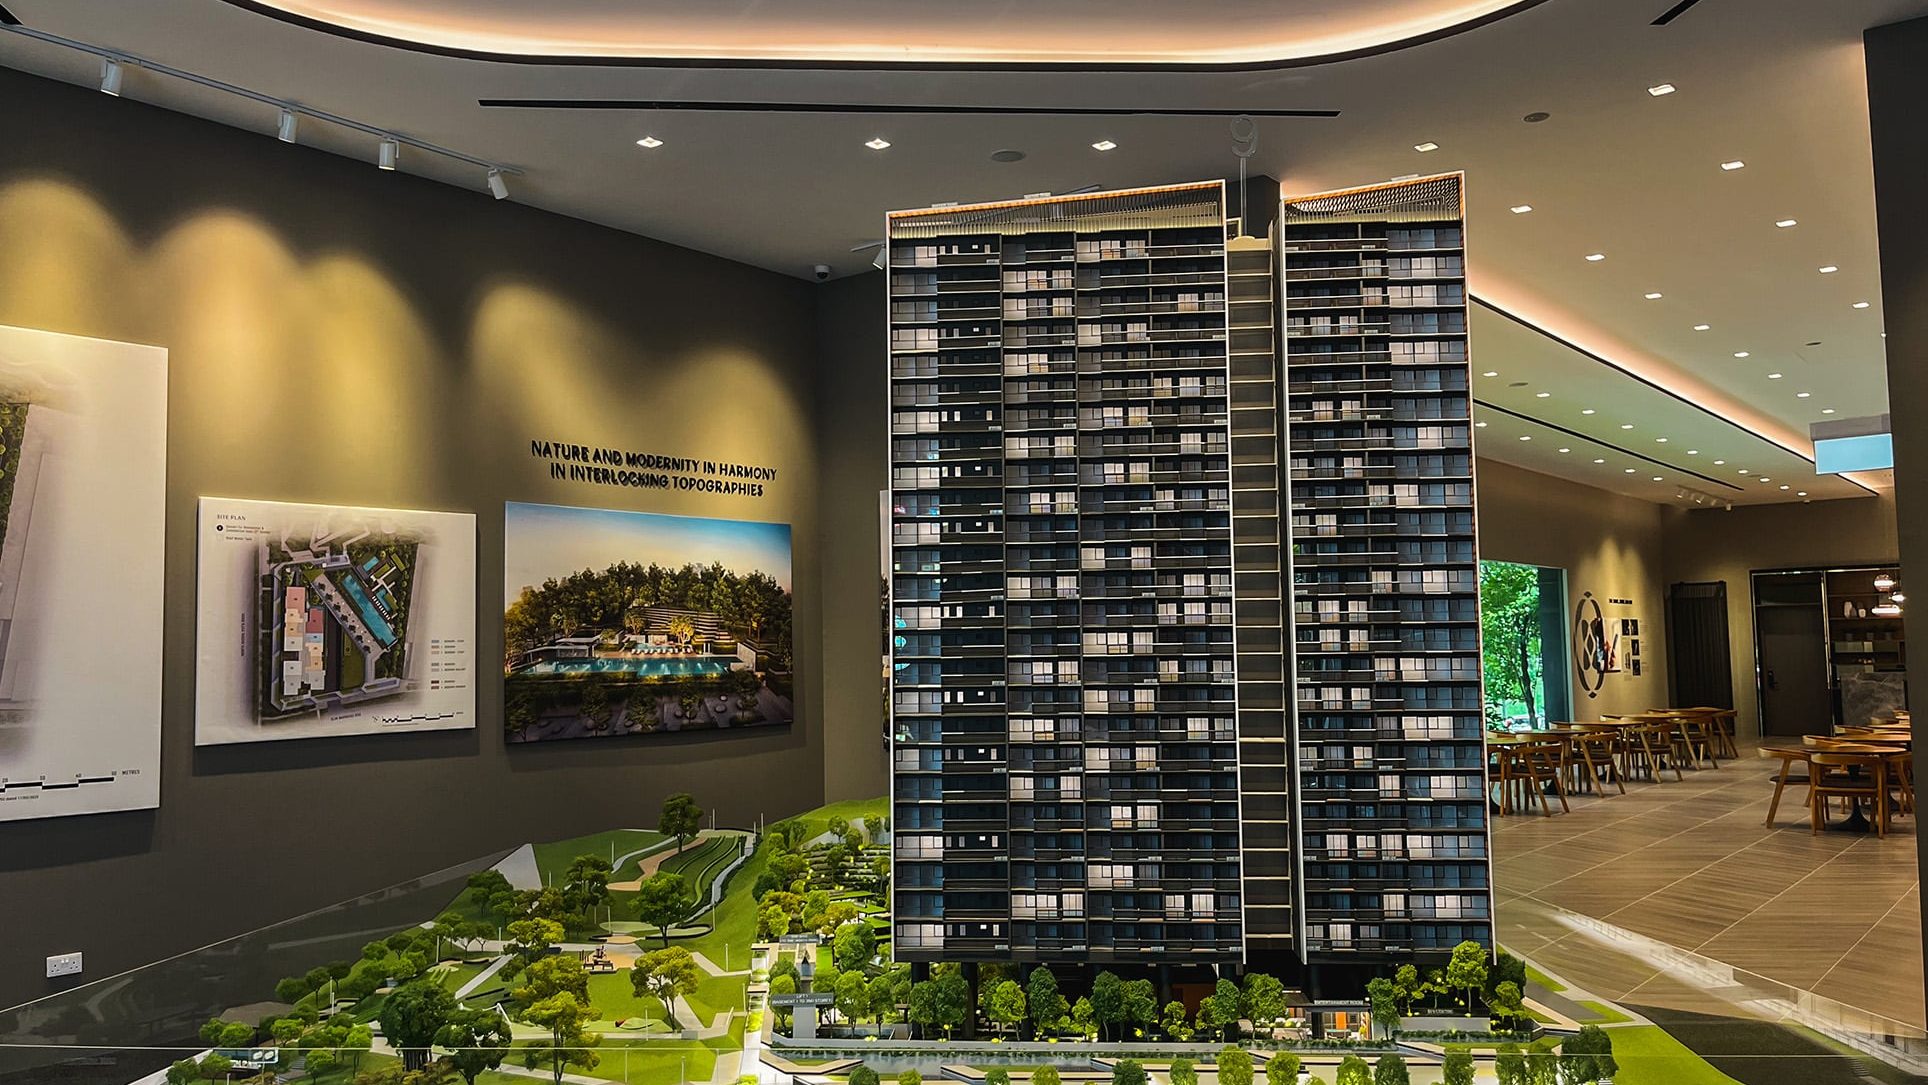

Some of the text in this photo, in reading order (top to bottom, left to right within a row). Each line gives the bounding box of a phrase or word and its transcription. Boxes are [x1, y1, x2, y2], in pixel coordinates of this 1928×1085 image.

[531, 440, 777, 481] NATURE AND MODERNITY IN HARMONY
[550, 462, 764, 497] IN INTERLOCKING TOPOGRAPHIES
